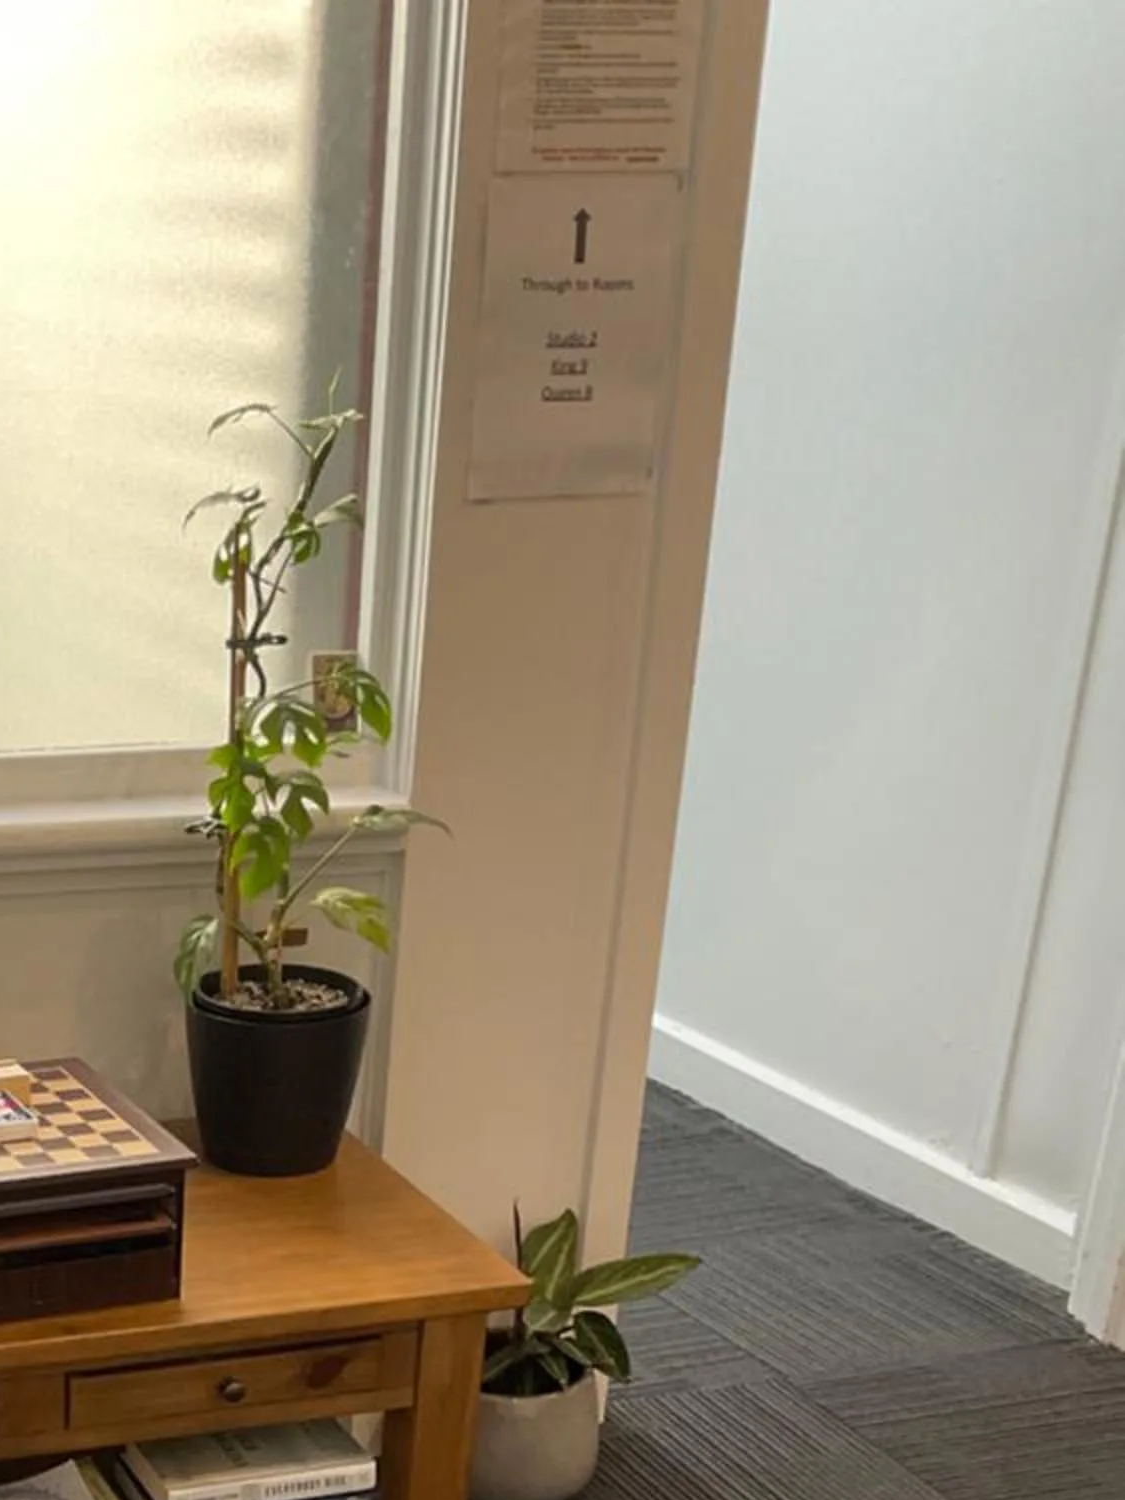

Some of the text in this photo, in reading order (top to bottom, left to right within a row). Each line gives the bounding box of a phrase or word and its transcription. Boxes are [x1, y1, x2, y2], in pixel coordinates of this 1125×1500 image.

[522, 277, 635, 295] Through to Rooms
[546, 330, 586, 347] Studio
[551, 358, 578, 375] King
[541, 385, 581, 402] Queen
